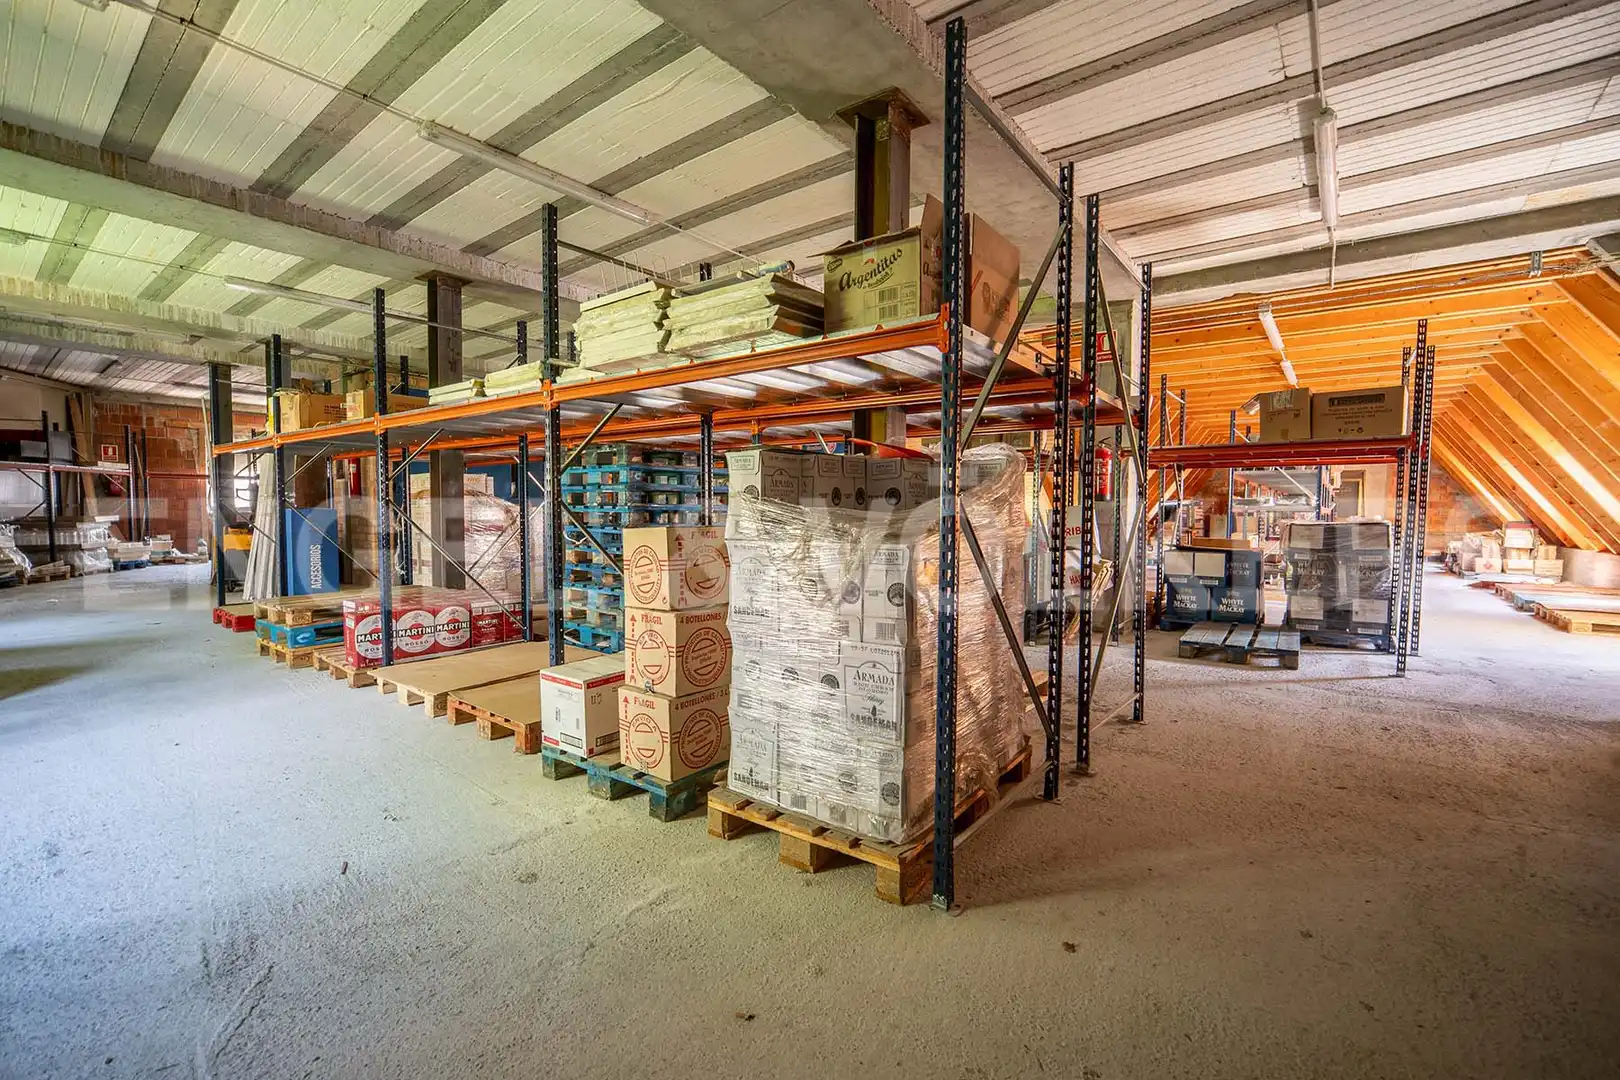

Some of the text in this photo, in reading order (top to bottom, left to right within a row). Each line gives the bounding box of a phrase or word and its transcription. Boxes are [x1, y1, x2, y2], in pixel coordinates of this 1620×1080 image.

[839, 248, 903, 291] Argentitas
[310, 544, 322, 588] ACCESORIOS
[686, 612, 722, 624] BOTELLONES
[398, 626, 435, 638] MARTINI
[436, 621, 470, 632] MARTINI
[357, 631, 397, 643] MARTI
[853, 669, 895, 686] ARMADA
[680, 692, 716, 710] BOTELLONES
